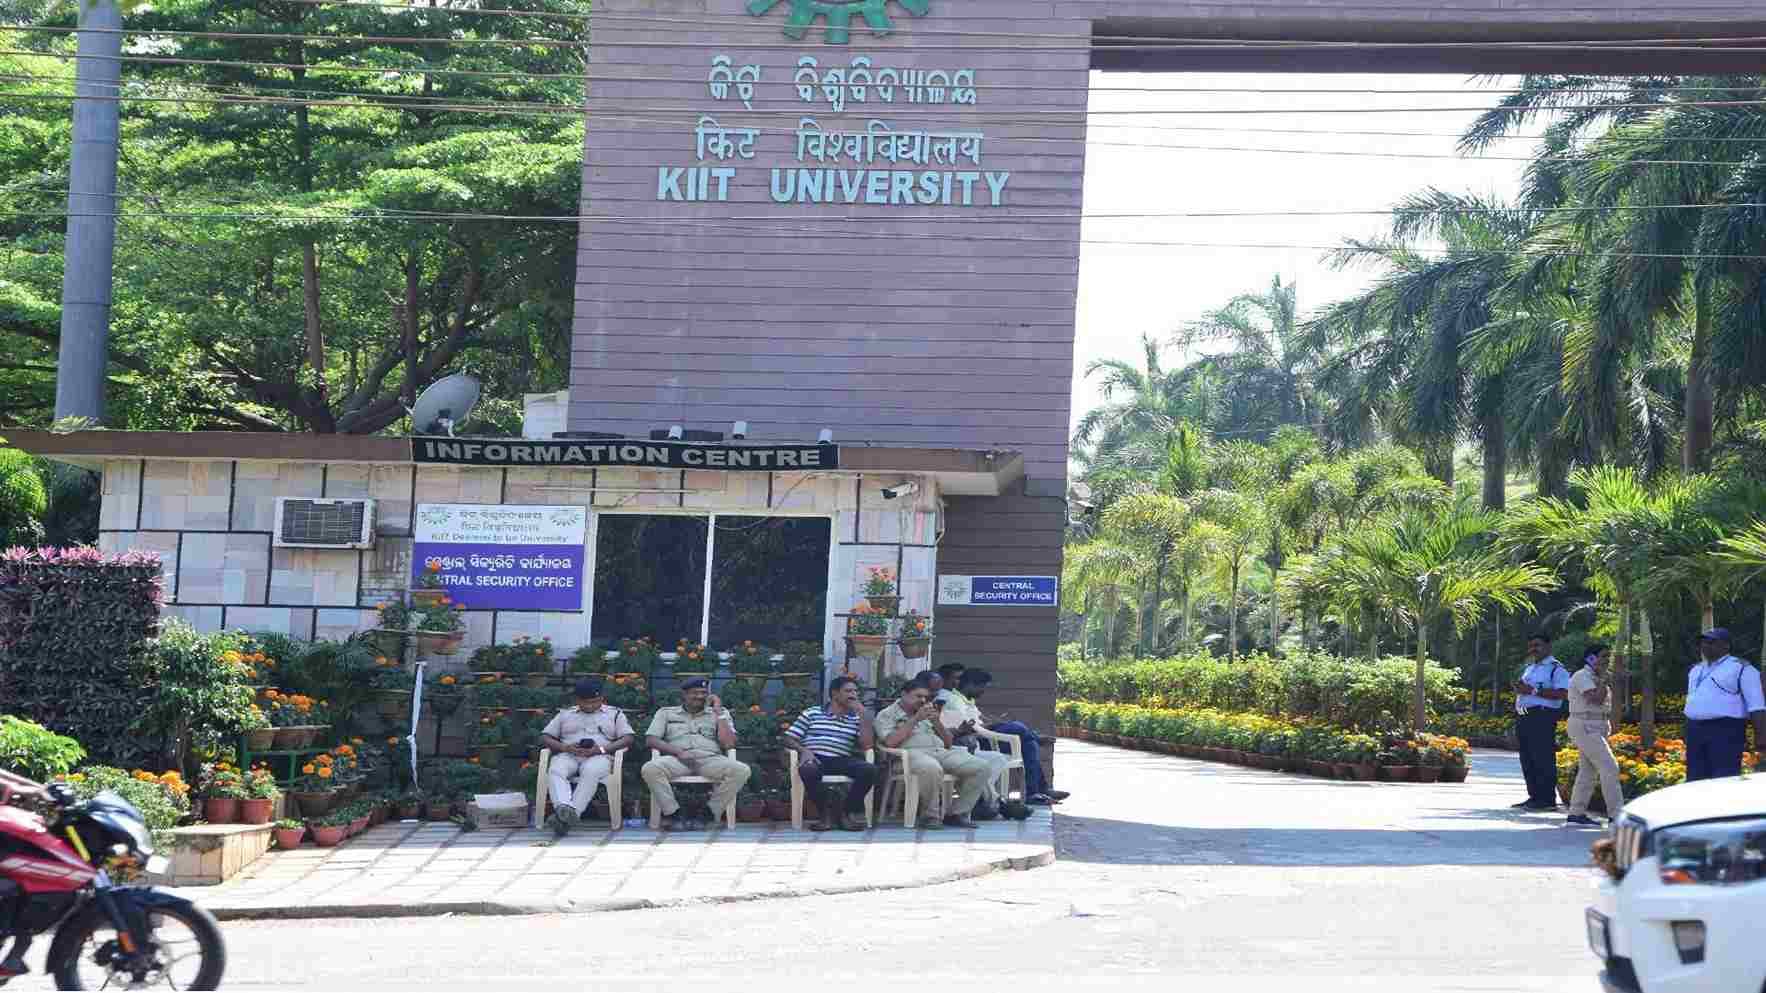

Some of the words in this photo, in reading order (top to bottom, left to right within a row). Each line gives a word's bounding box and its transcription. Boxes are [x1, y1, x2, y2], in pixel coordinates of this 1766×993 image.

[696, 116, 760, 160] किट
[797, 117, 984, 165] विश्वविद्यालय
[656, 167, 735, 201] KIIT
[770, 168, 1010, 206] UNIVERSITY
[426, 441, 669, 464] INFORMATION
[682, 447, 820, 467] CENTRE
[430, 574, 473, 587] TRAL
[476, 575, 531, 587] SECURITY
[535, 575, 575, 588] OFFICE
[992, 582, 1035, 590] CENTRAL
[974, 591, 1018, 600] SECURITY
[1020, 591, 1052, 601] OFFICE
